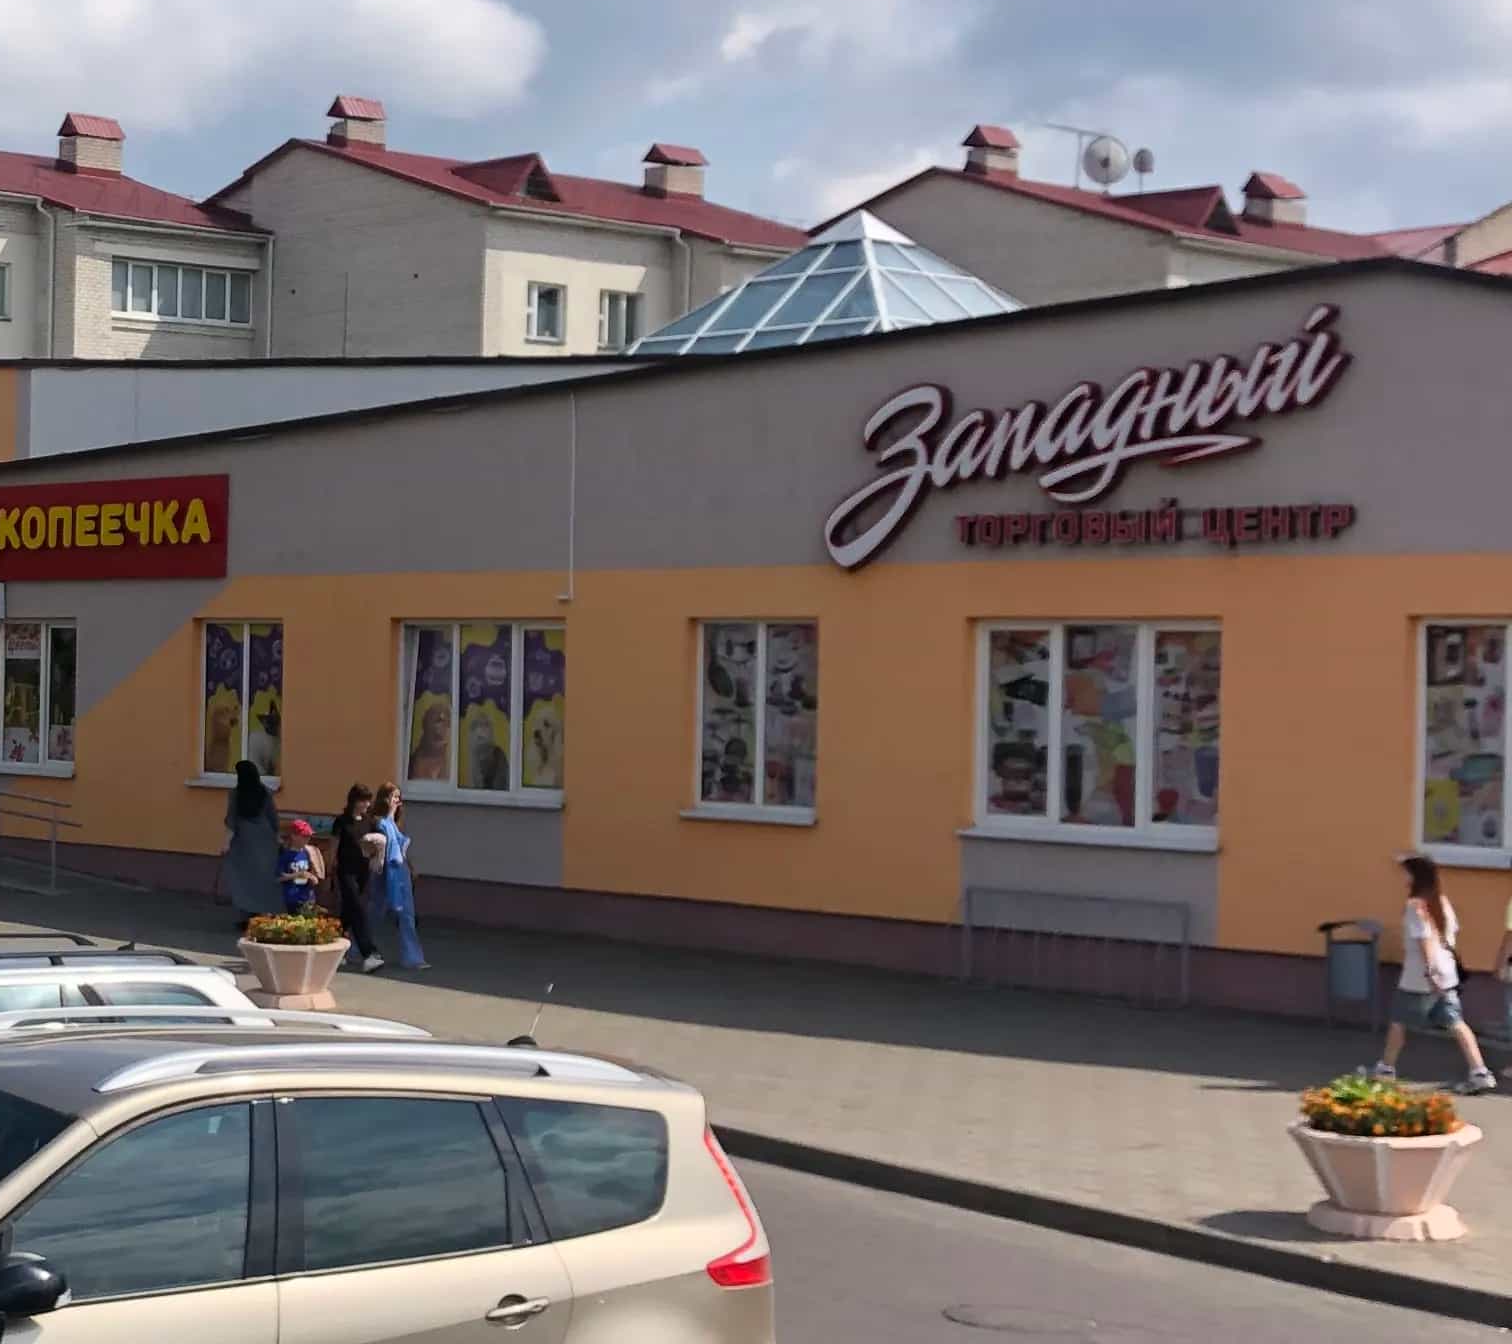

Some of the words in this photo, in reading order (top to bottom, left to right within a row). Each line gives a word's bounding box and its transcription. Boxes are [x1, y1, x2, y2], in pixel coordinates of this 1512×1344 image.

[825, 304, 1349, 567] Западный
[954, 498, 1179, 545] ТОРГОВЫЙ
[1201, 503, 1354, 548] ЦЕНТР
